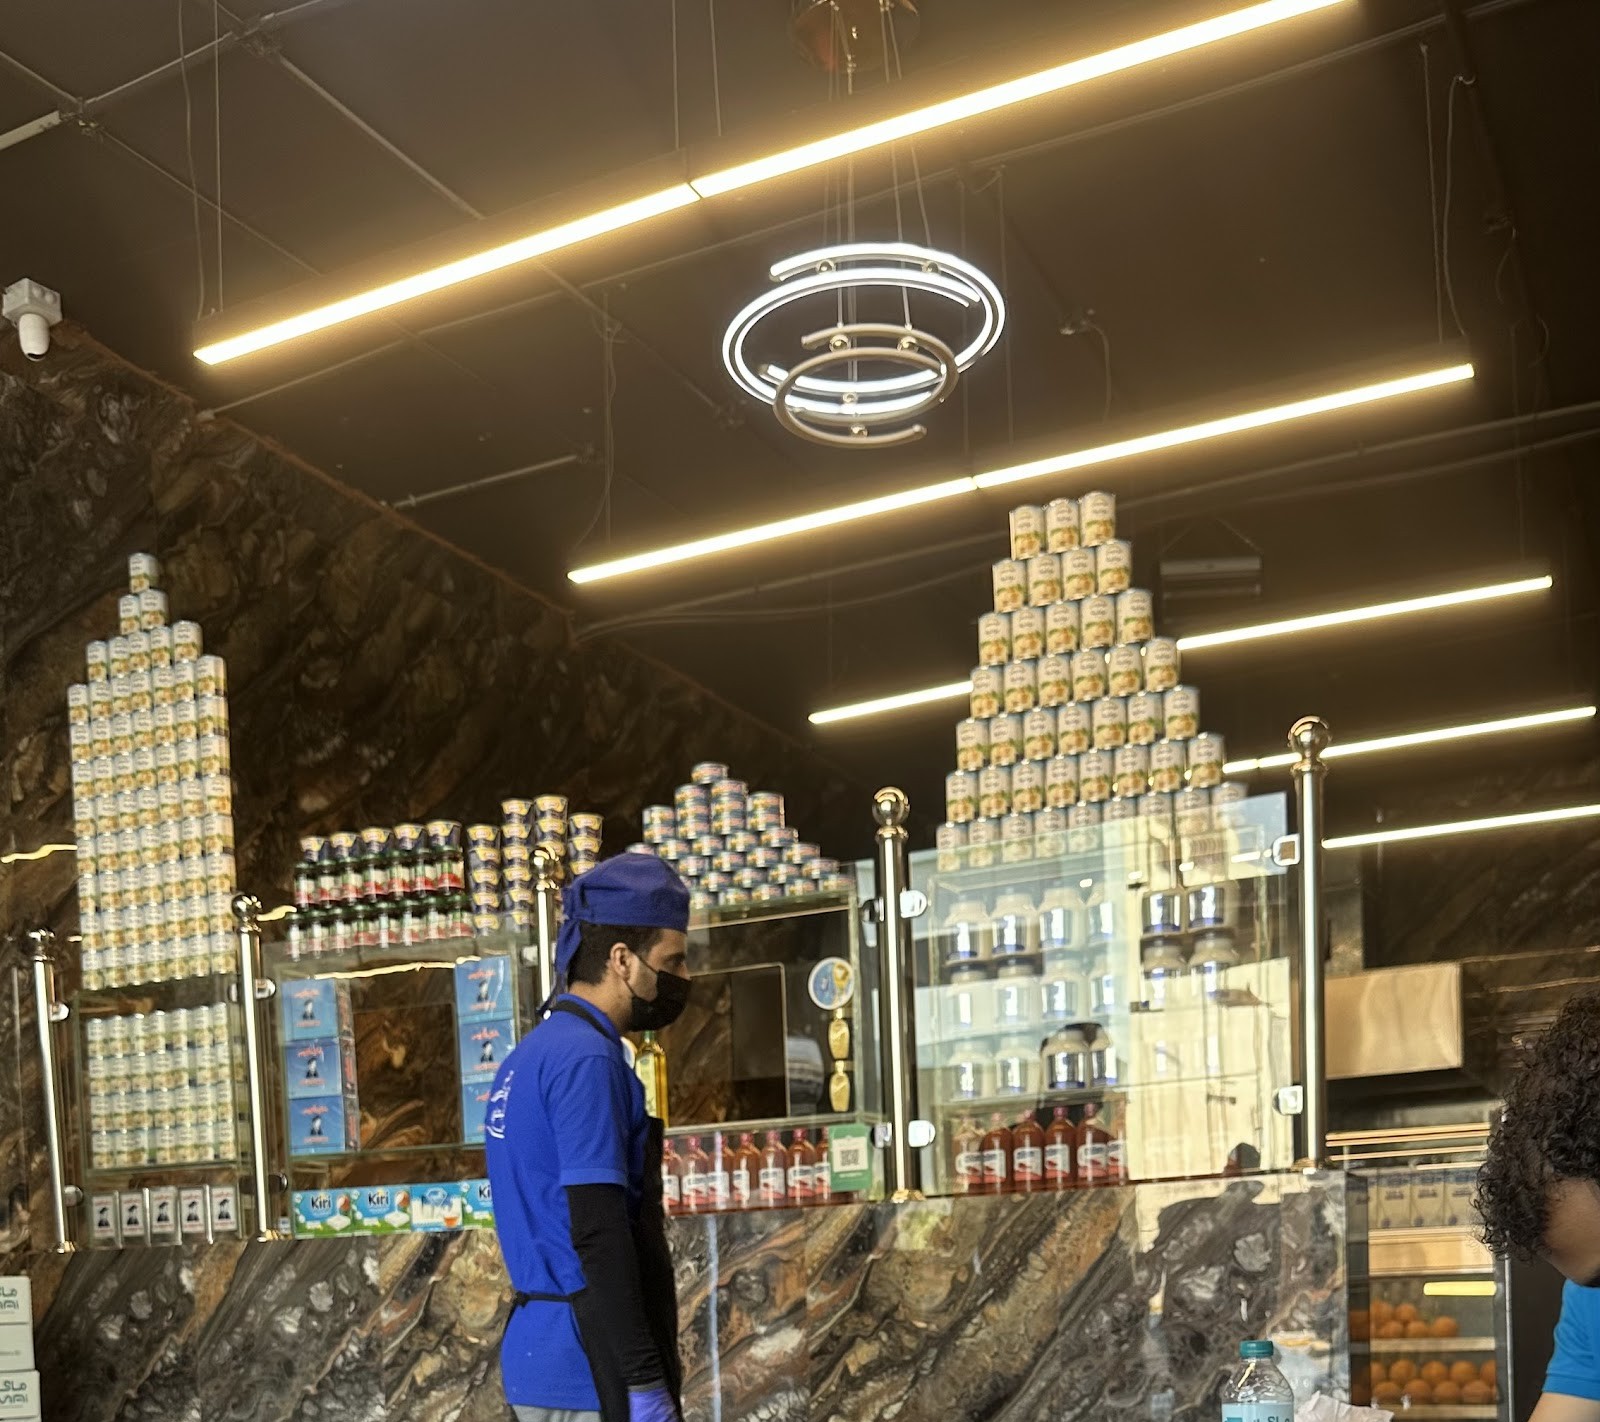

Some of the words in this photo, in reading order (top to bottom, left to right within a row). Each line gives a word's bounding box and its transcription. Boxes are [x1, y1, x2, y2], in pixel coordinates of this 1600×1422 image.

[368, 1191, 390, 1205] Kiri
[478, 1184, 491, 1199] Ki
[310, 1194, 332, 1209] Kiri
